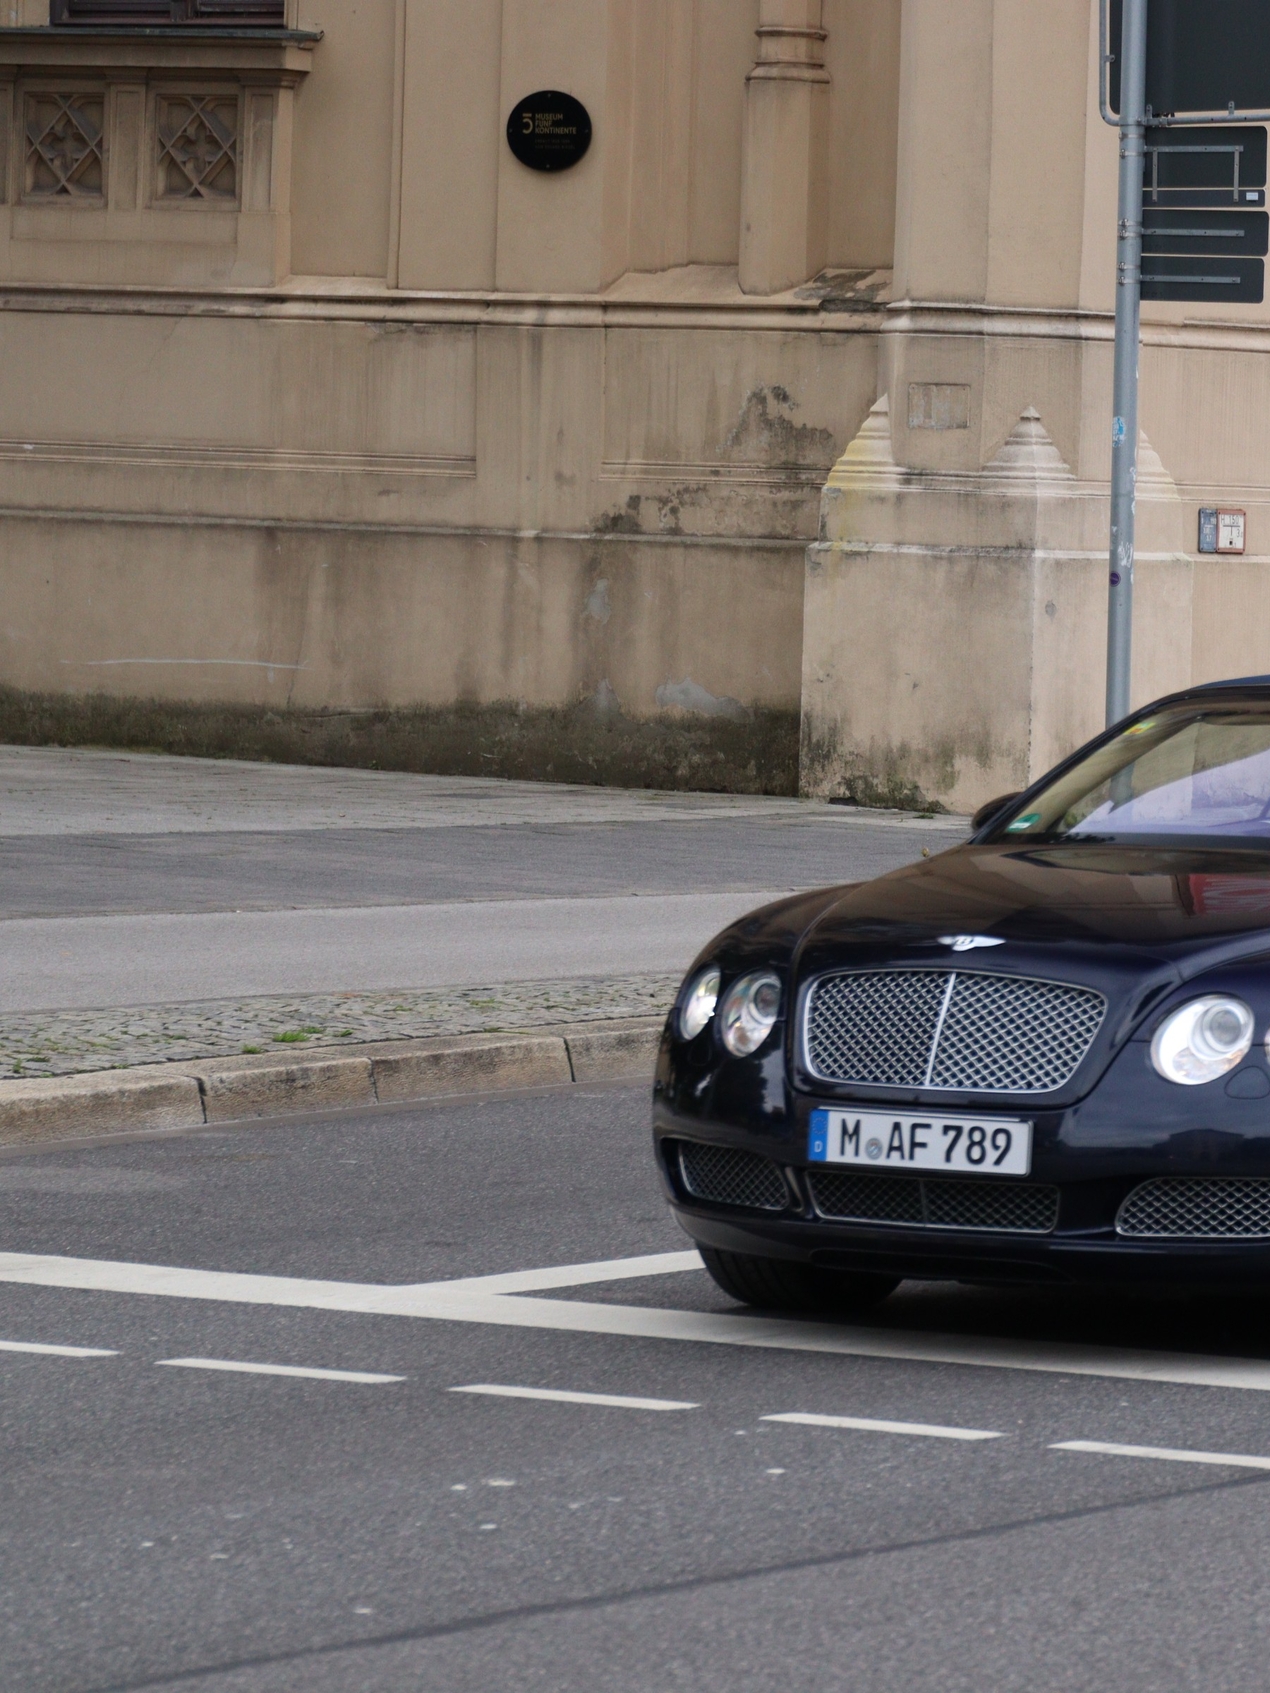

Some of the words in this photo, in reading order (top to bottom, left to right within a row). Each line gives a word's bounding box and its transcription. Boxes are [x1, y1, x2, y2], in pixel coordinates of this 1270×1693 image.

[522, 113, 533, 134] 5
[535, 113, 564, 121] MUSEUM
[535, 127, 577, 135] KONTINENTE
[814, 1141, 824, 1153] D
[840, 1118, 861, 1157] M
[886, 1121, 932, 1161] AF
[942, 1124, 1012, 1167] 789
